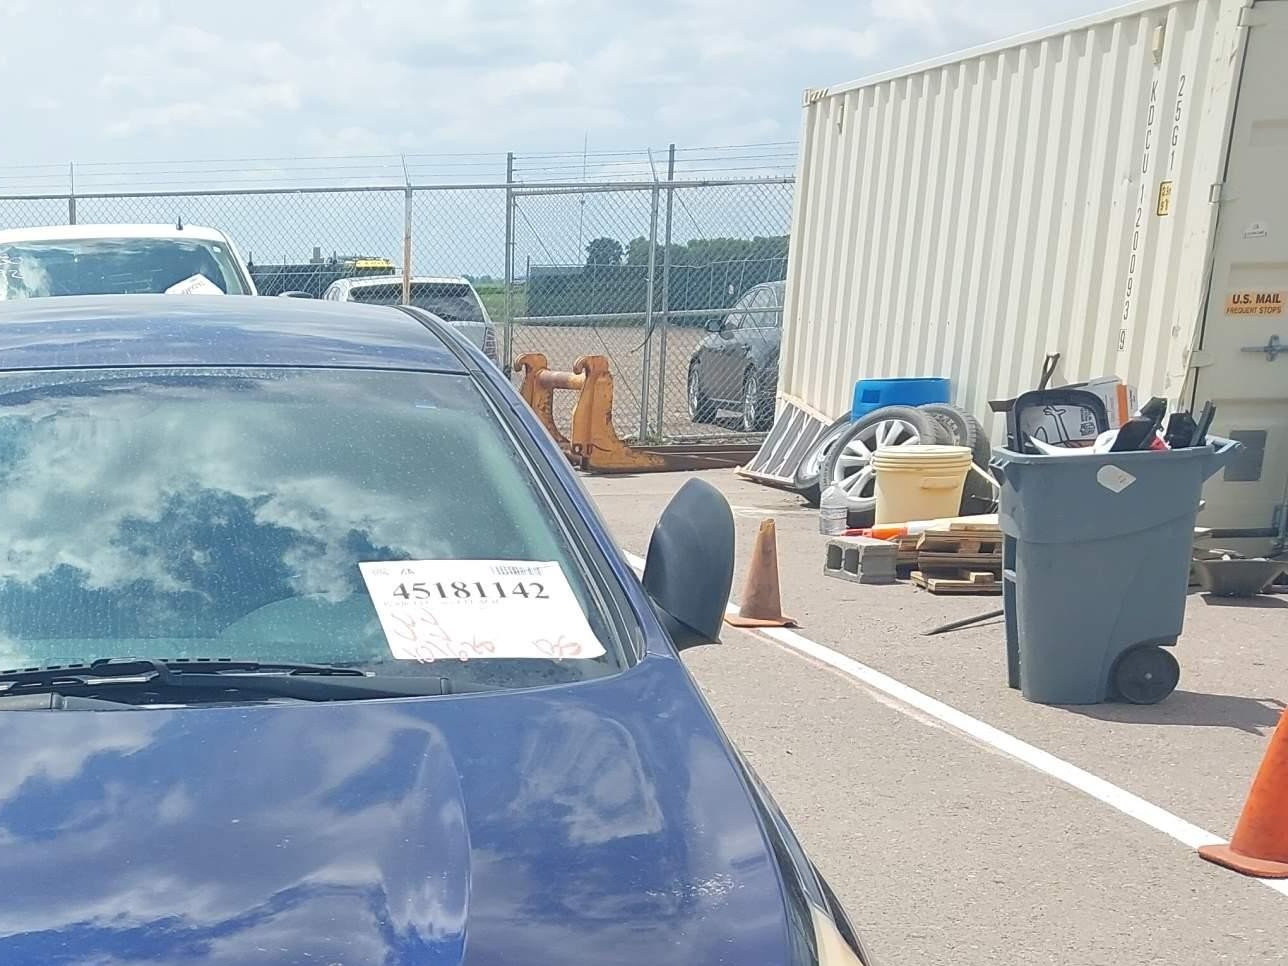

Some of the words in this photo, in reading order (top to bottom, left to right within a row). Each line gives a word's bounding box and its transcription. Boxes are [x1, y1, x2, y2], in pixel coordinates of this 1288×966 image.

[1142, 80, 1159, 174] KDCU
[1170, 75, 1186, 170] 25G1
[1232, 293, 1253, 304] U.S.
[1255, 293, 1281, 304] MAIL
[1226, 306, 1258, 314] FREQUENT
[1259, 306, 1282, 314] STOPS
[392, 581, 550, 599] 45181142
